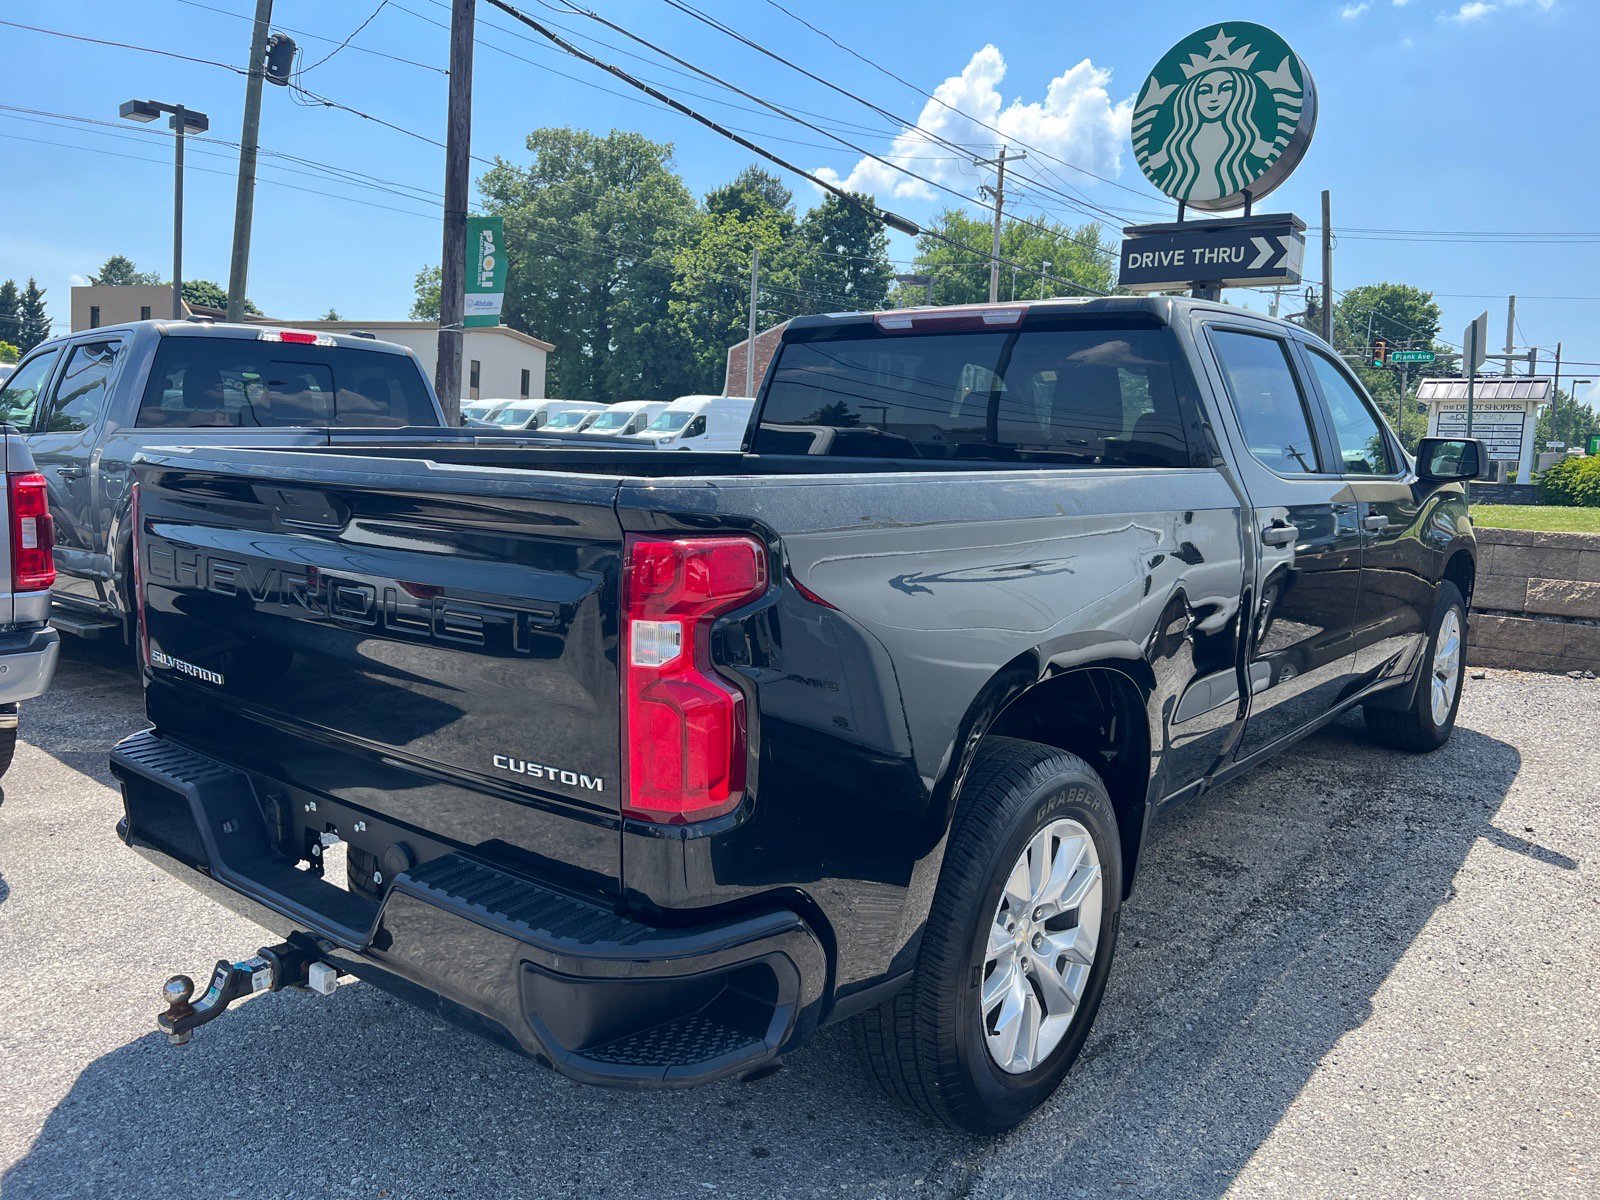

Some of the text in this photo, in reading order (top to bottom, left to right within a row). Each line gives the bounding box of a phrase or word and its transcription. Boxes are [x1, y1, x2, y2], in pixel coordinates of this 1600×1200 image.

[481, 230, 496, 287] PAOLI
[1128, 246, 1245, 269] DRIVE THRU
[1455, 403, 1483, 411] DEOT
[1484, 403, 1523, 411] SHOPPES
[146, 543, 560, 654] CHEVROLET
[151, 649, 225, 686] SILVERADO
[492, 753, 605, 793] CUSTOM
[1036, 787, 1101, 824] GRABBER
